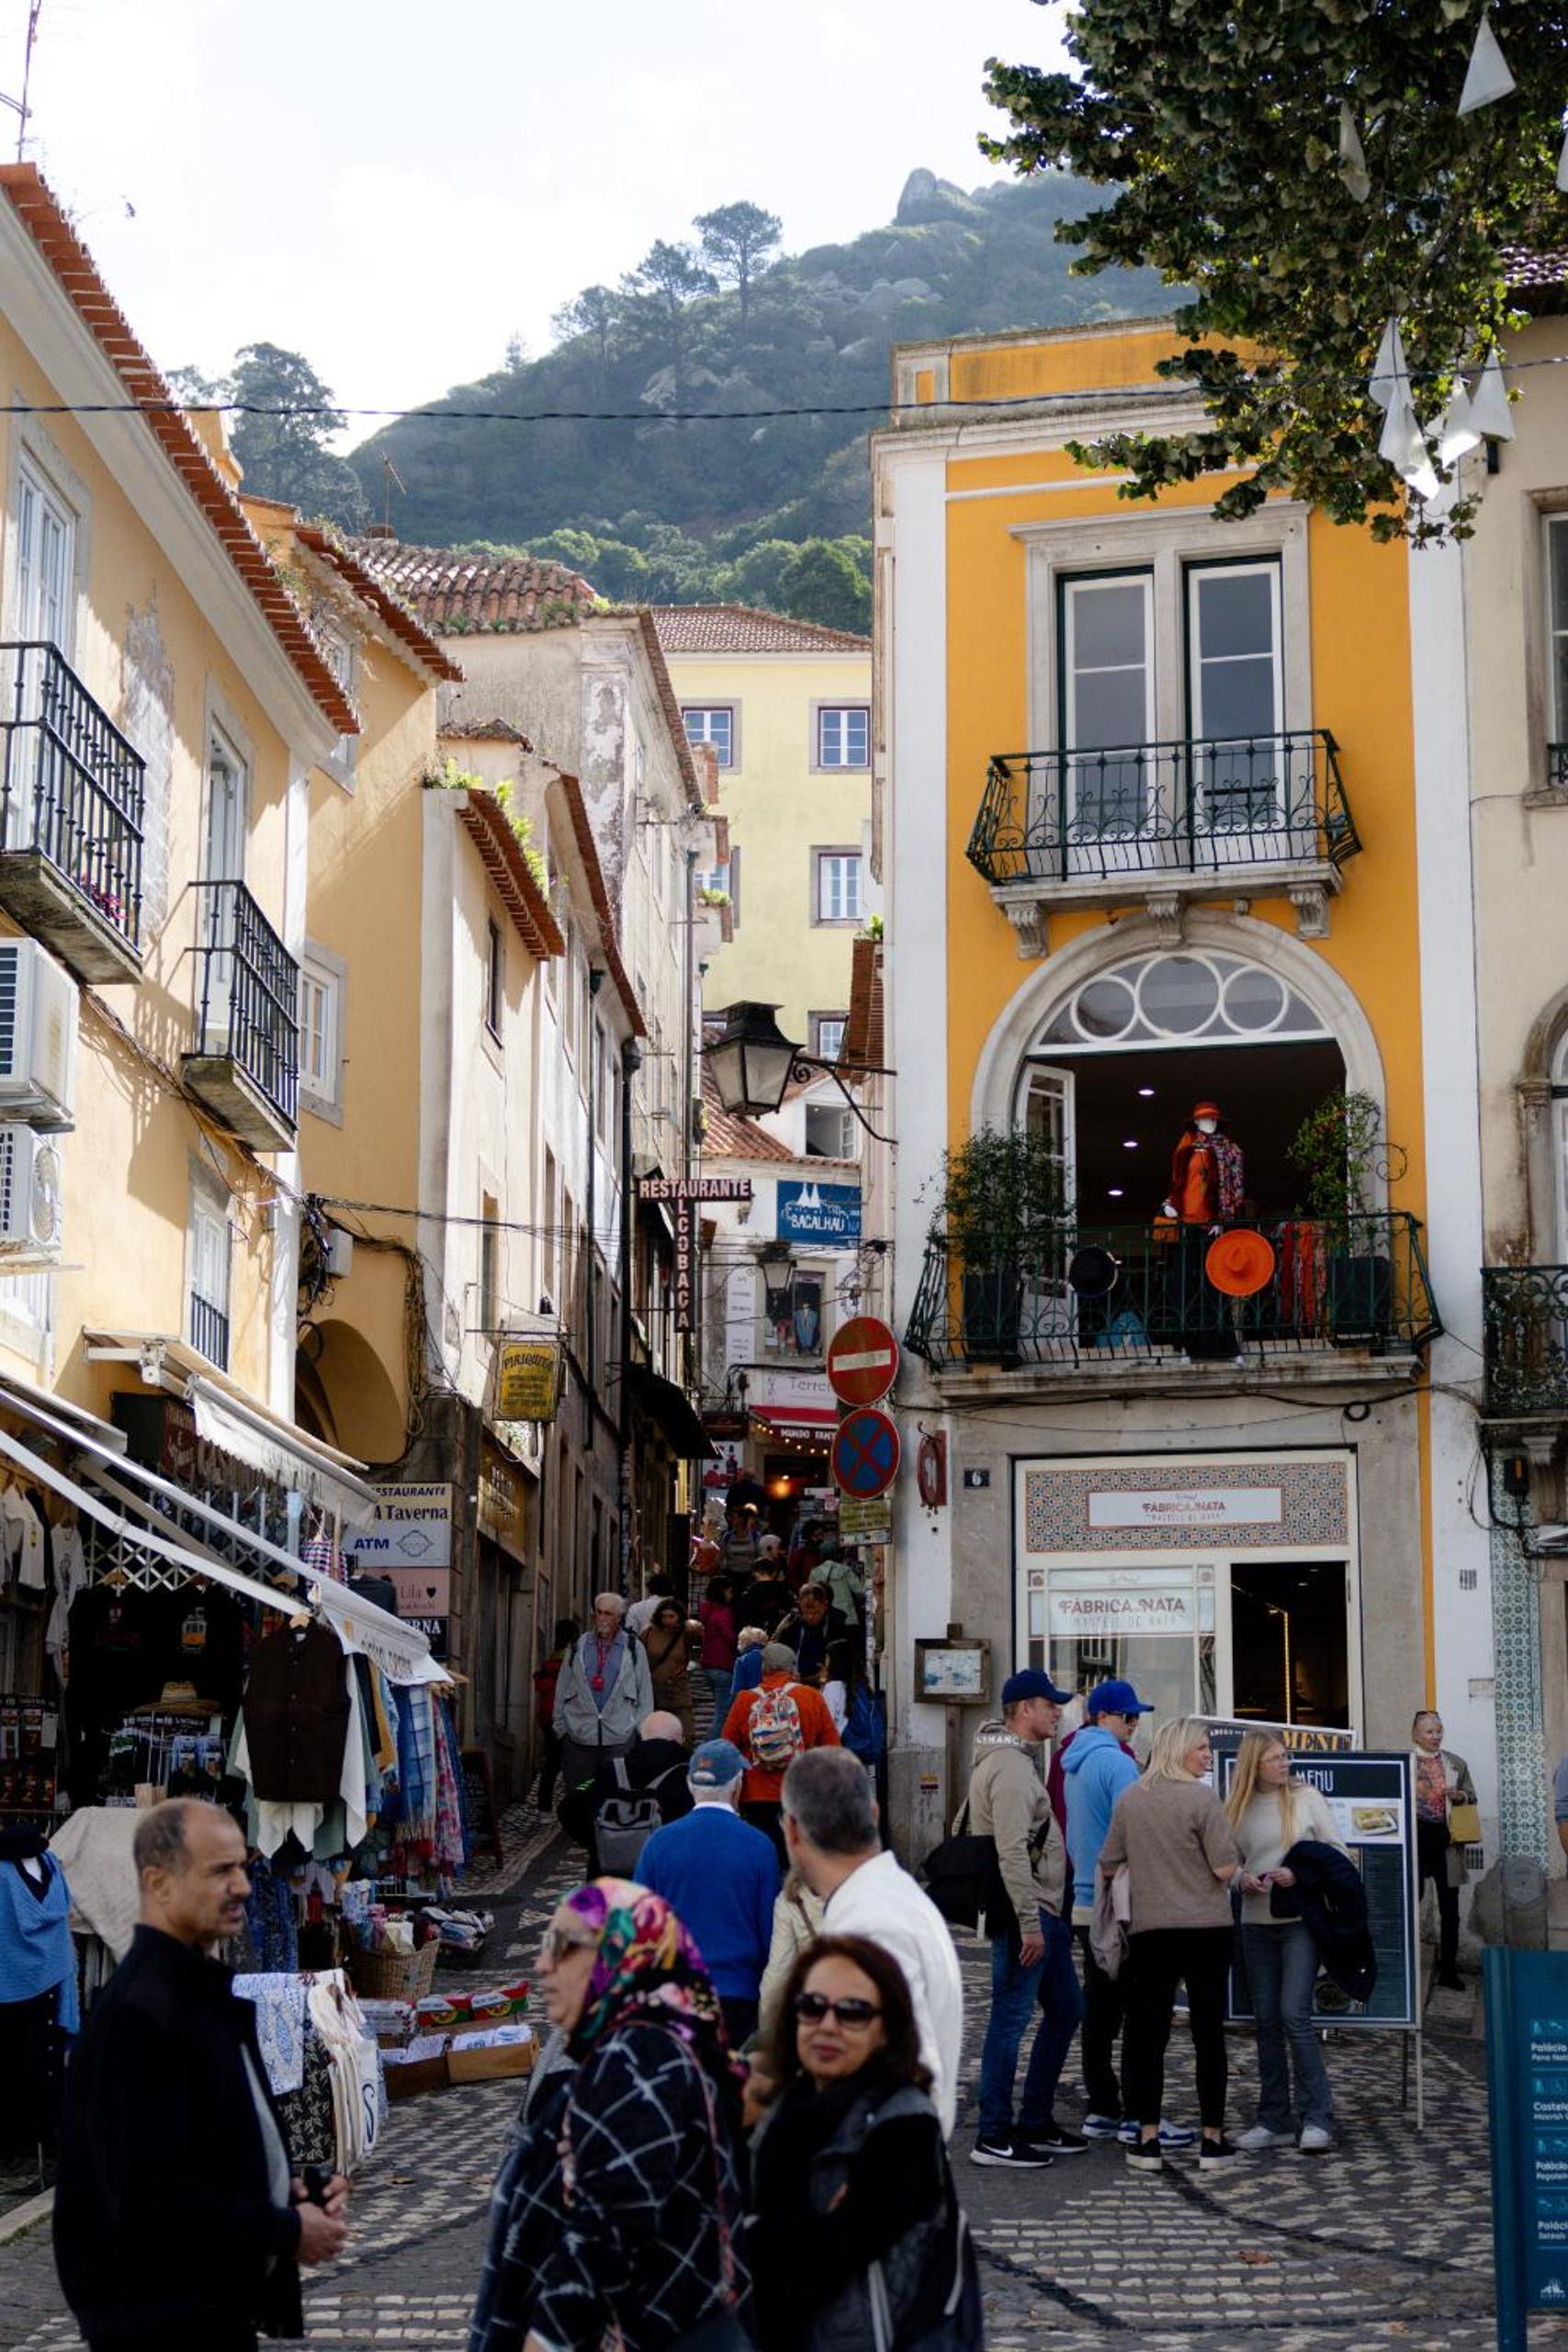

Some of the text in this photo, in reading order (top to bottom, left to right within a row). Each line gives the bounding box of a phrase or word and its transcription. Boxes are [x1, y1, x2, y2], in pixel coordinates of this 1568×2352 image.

[638, 1180, 750, 1198] RESTAURANTE
[791, 1214, 845, 1232] BACALHAU
[972, 1471, 982, 1486] 6
[372, 1487, 446, 1497] ESTAURANTE
[374, 1505, 448, 1521] A Taverna
[354, 1538, 389, 1550] ATM
[1139, 1597, 1186, 1612] NATA
[1297, 1770, 1335, 1792] MENU
